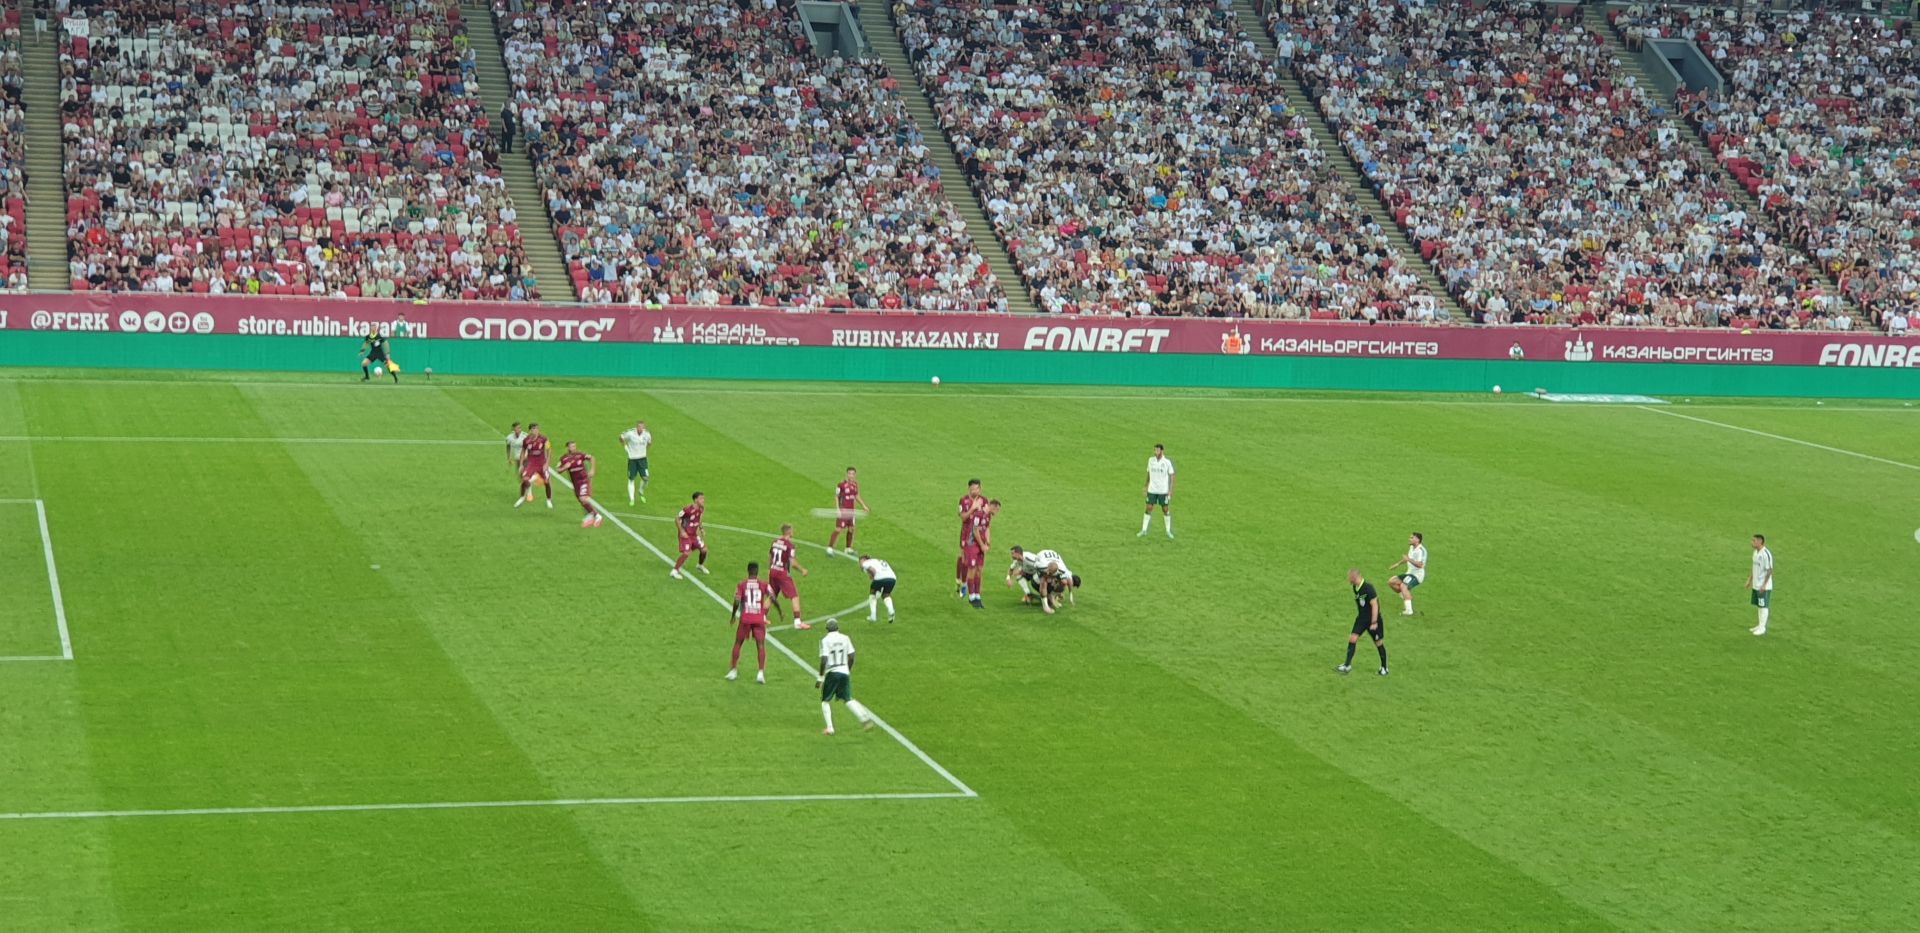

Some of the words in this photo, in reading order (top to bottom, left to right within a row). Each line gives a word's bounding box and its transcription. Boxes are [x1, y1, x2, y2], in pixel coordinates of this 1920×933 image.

[31, 310, 110, 331] @FCRK
[238, 315, 427, 338] store.rubin-kaaru
[692, 322, 766, 337] КАЗАНЬ
[1024, 326, 1170, 353] FONBET
[1261, 338, 1439, 356] КАЗАНЬОРГСИНТЕЗ
[1602, 344, 1774, 362] КАЗАНЬОРГСИНТЕЗ
[744, 589, 762, 607] 12
[830, 649, 845, 666] 11
